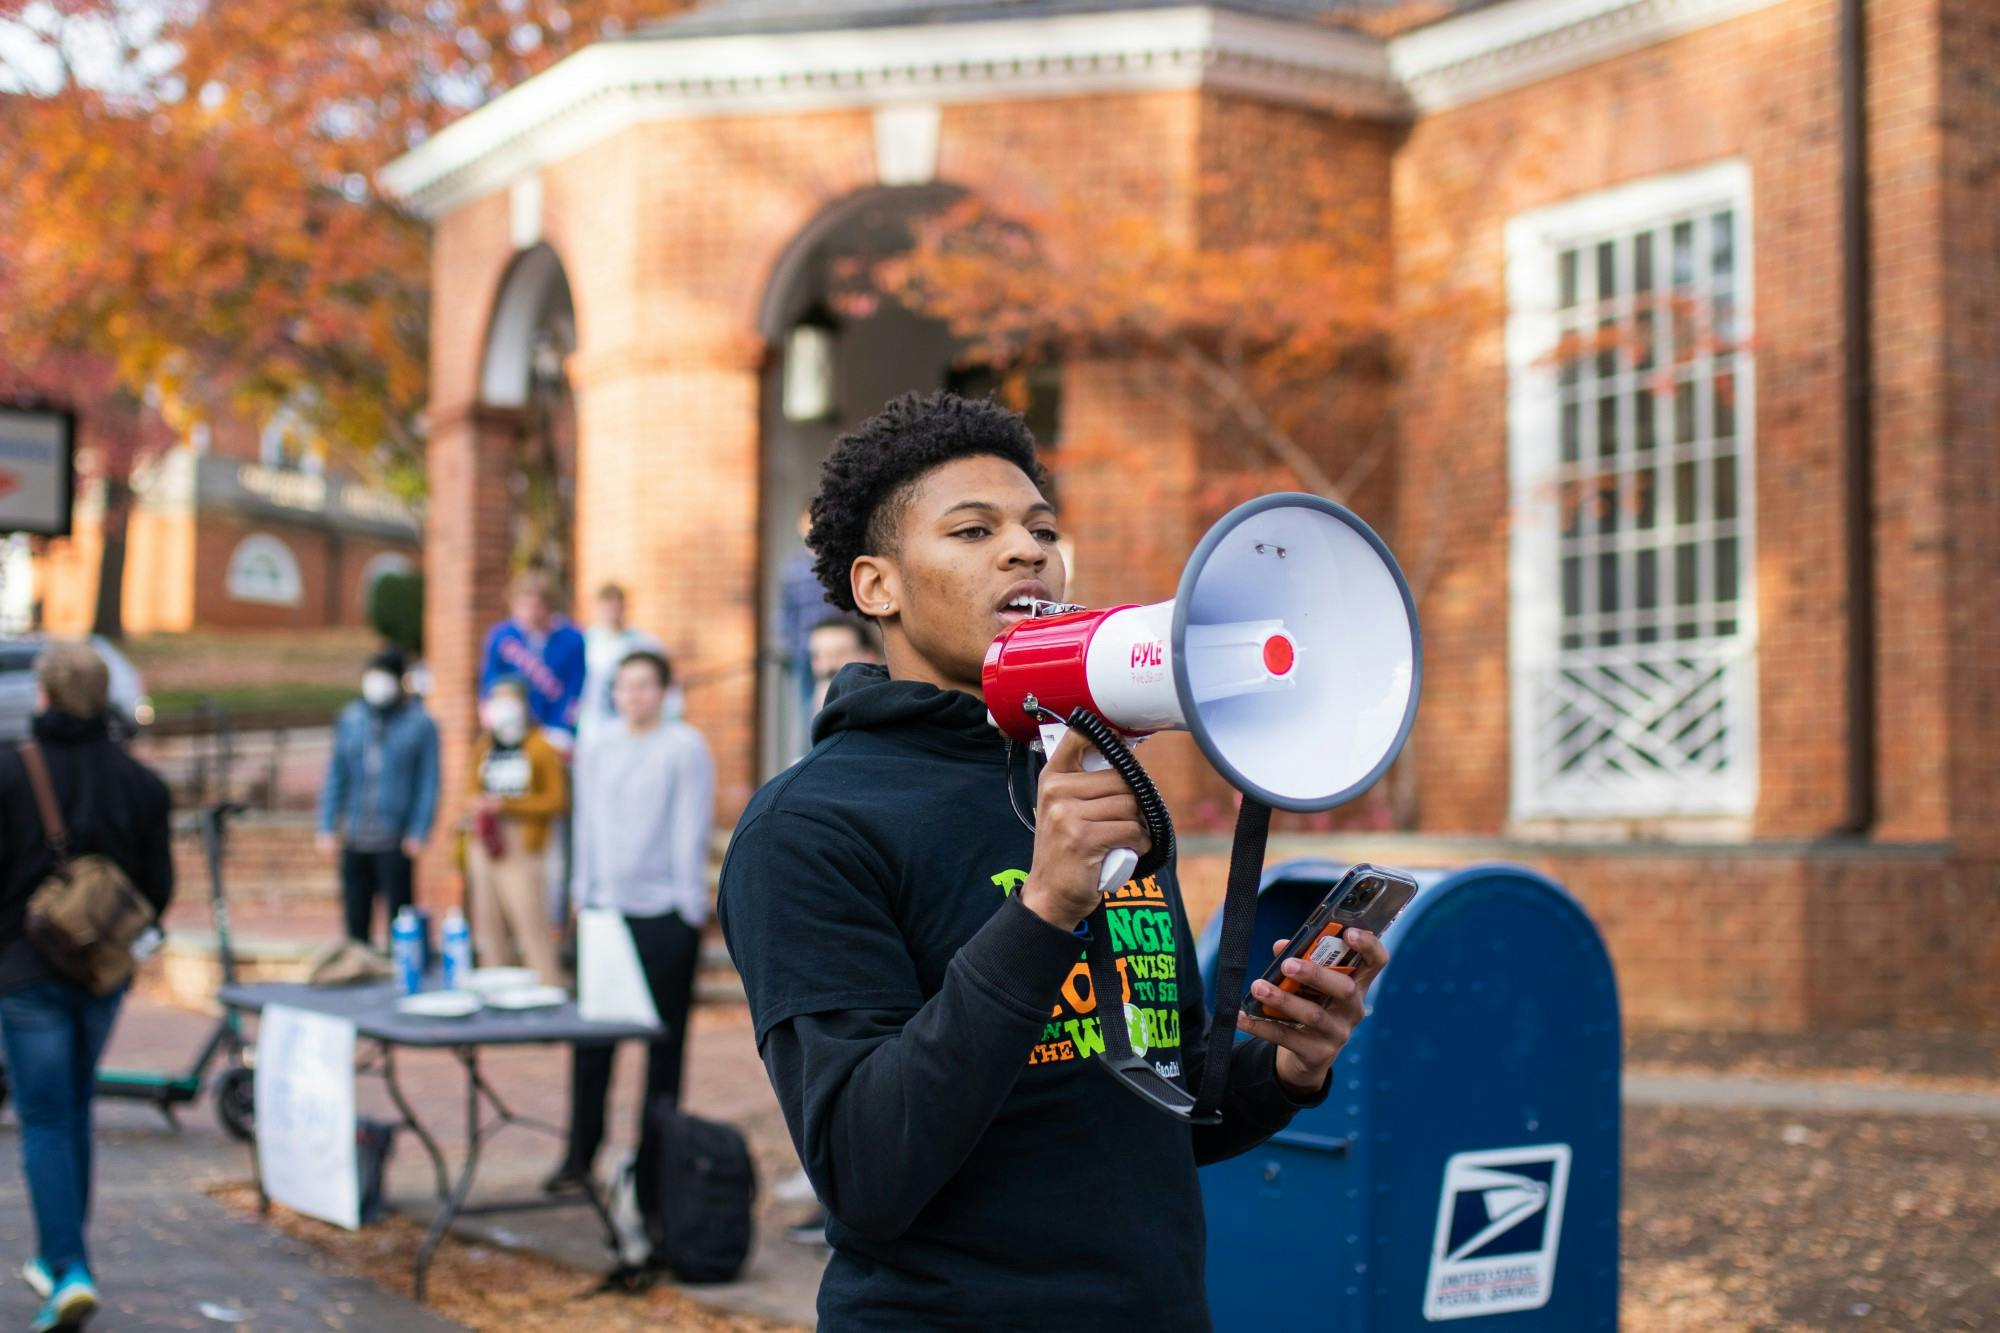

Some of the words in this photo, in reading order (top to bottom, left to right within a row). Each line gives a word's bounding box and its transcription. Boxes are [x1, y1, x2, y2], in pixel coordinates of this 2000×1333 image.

[1130, 640, 1164, 668] PYLE
[1103, 874, 1165, 899] HE
[1105, 908, 1176, 953] NGE
[1133, 982, 1156, 1001] TO
